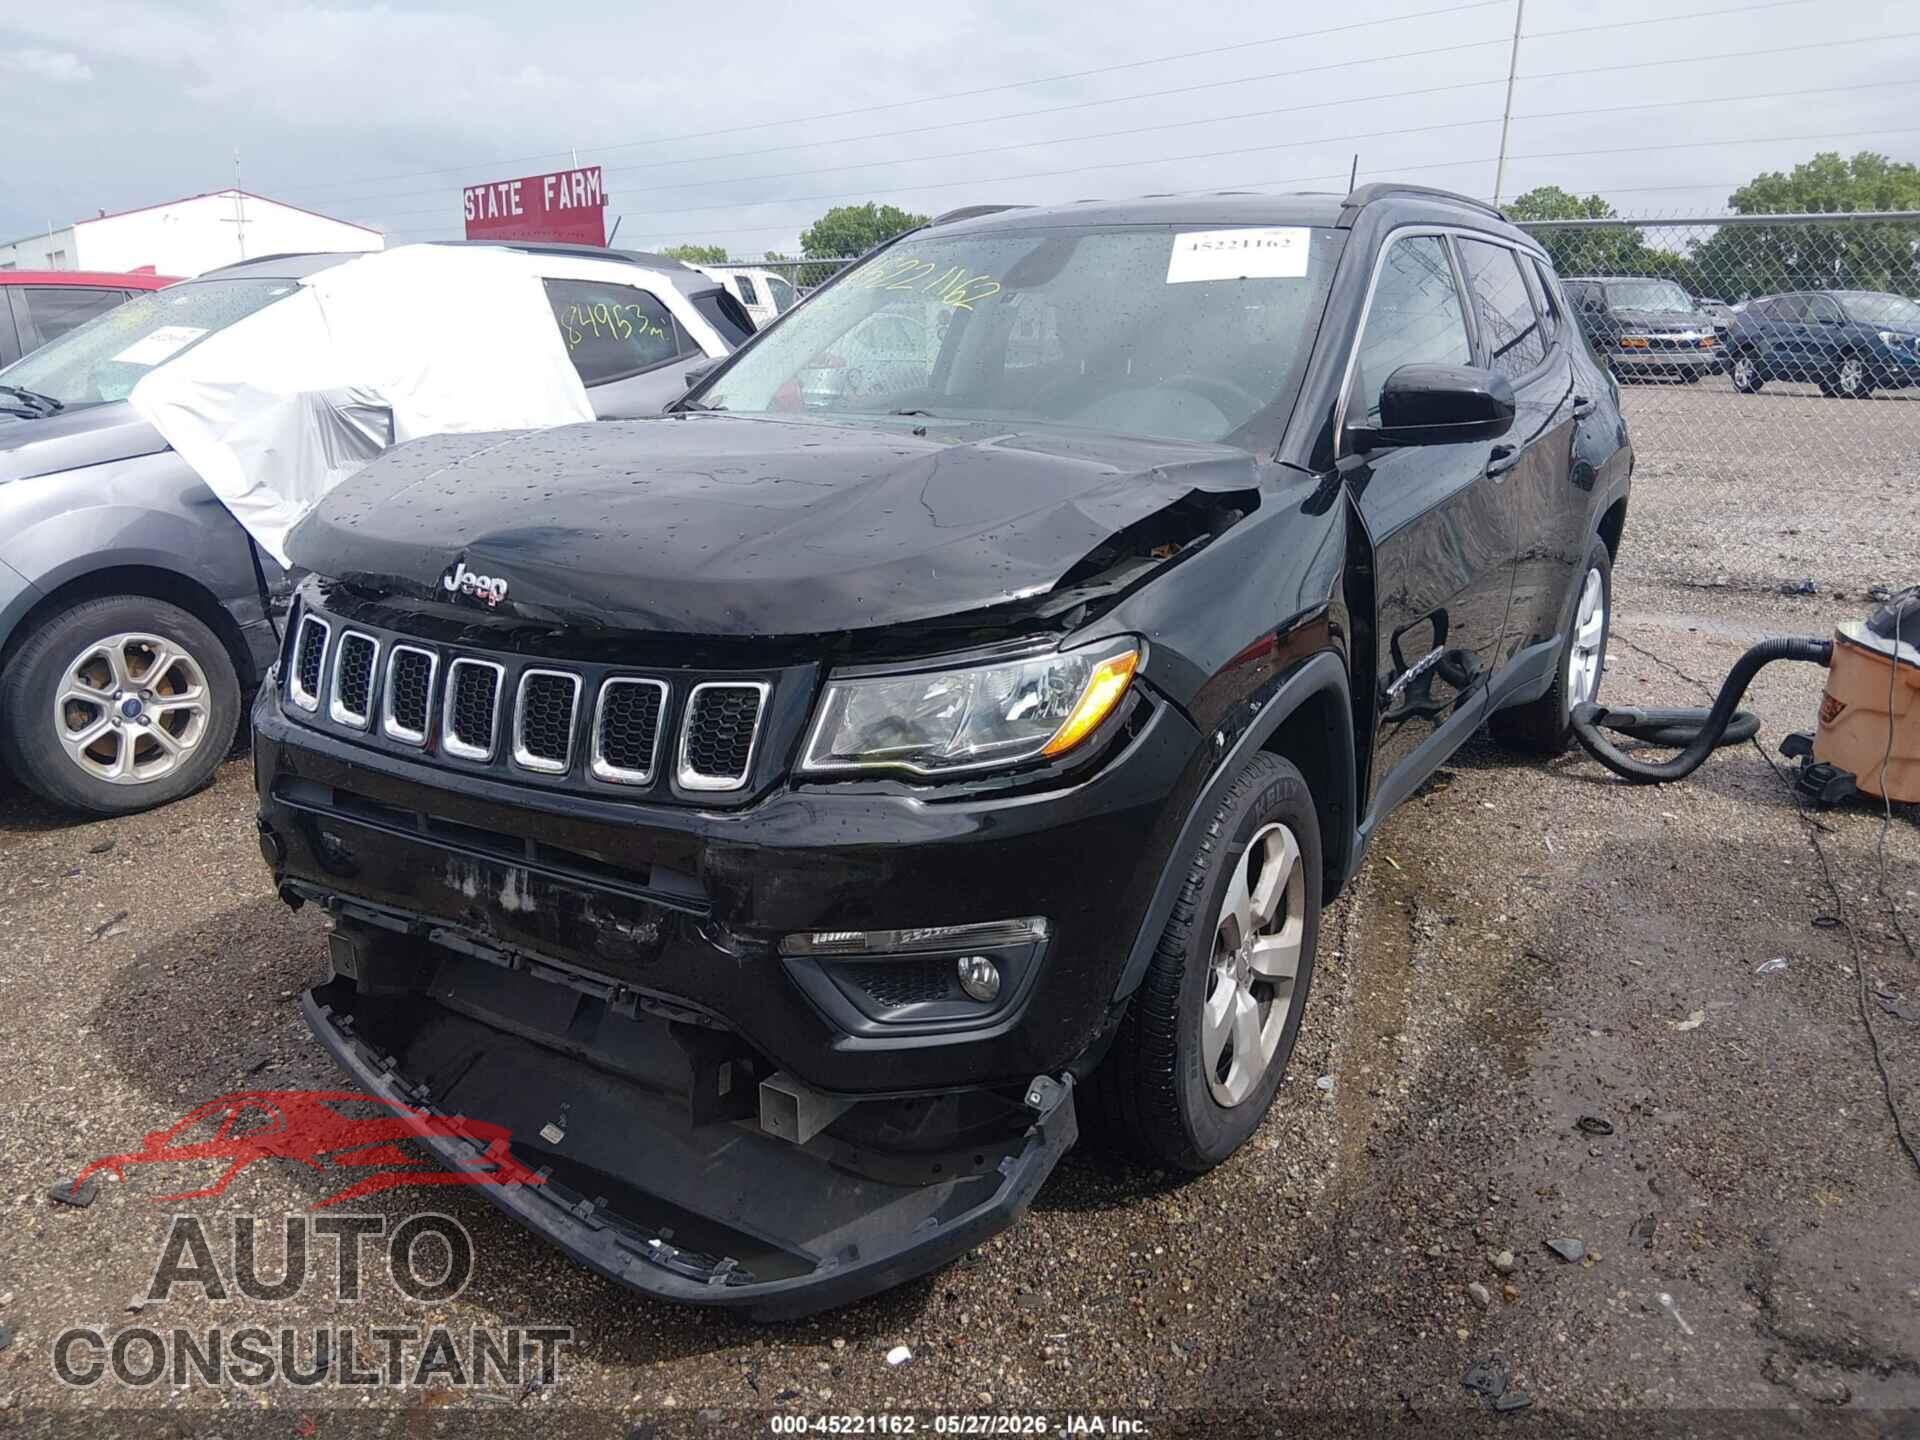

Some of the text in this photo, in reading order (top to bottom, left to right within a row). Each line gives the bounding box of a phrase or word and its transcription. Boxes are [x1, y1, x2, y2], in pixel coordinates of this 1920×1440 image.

[464, 170, 601, 221] STATE FARM
[444, 563, 508, 607] Jeep
